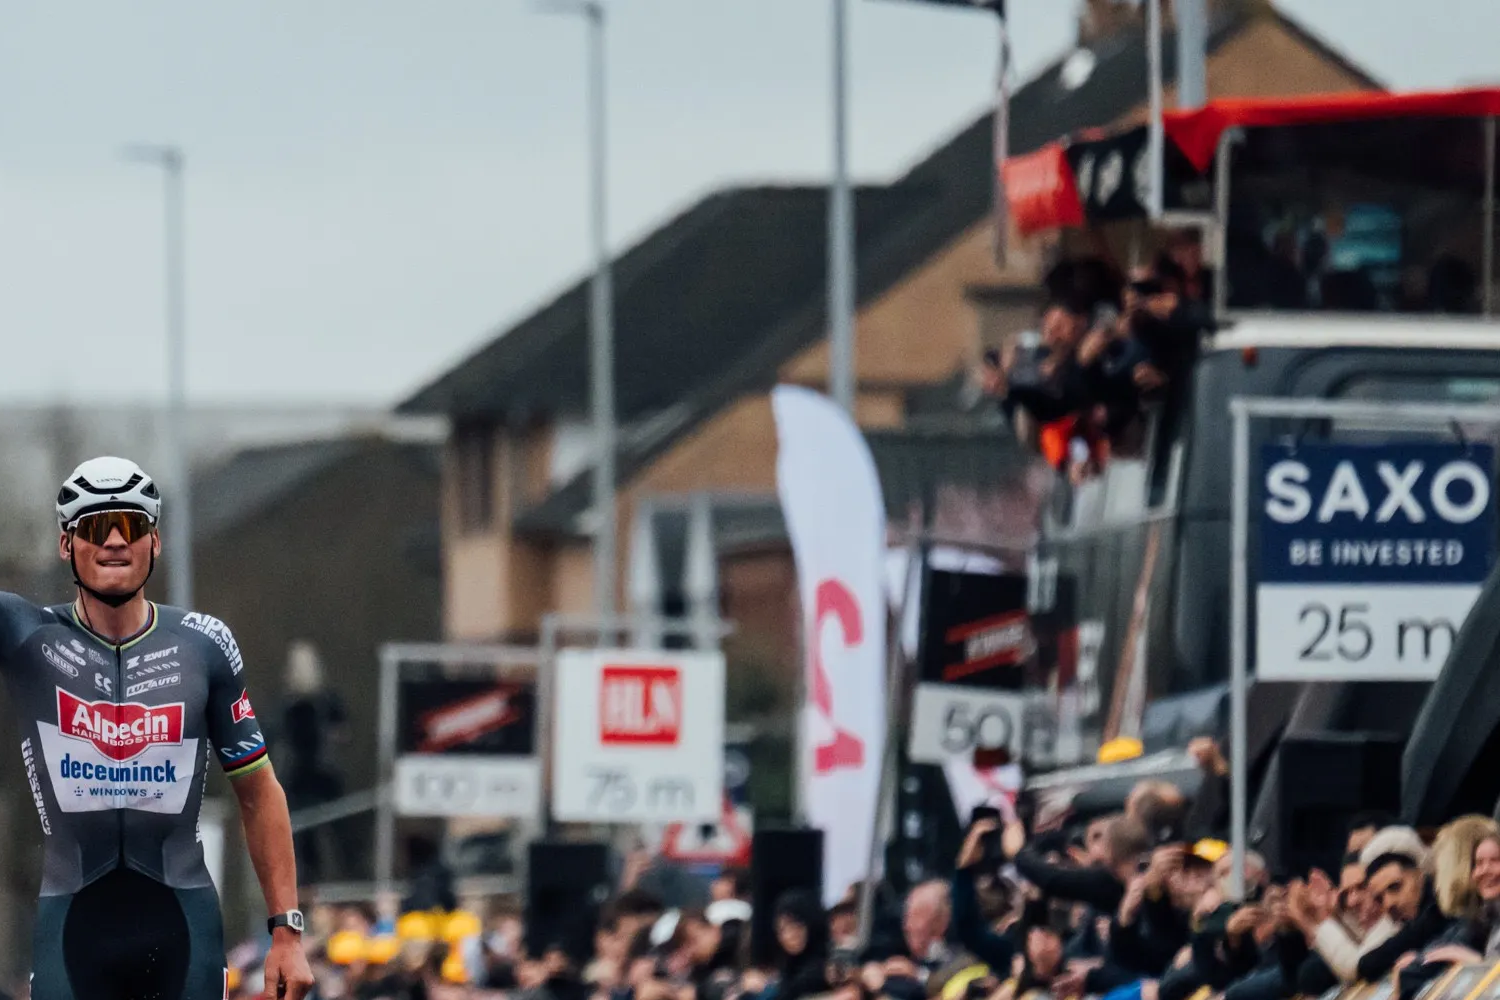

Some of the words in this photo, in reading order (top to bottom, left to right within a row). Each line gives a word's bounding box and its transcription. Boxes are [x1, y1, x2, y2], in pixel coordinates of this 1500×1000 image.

[1266, 460, 1490, 524] SAXO
[1289, 539, 1323, 566] BE
[1331, 539, 1464, 566] INVESTED
[180, 620, 204, 632] HAIR
[209, 631, 238, 676] BOOSTER
[183, 612, 244, 673] Alpecin
[1298, 602, 1374, 661] 25
[1398, 617, 1457, 660] m
[144, 646, 178, 662] ZWIFT
[71, 703, 169, 743] Alpecin
[72, 726, 101, 740] HAIR
[109, 734, 169, 747] BOOSTER
[942, 701, 1012, 754] 50
[60, 752, 177, 782] deceuninck
[89, 787, 148, 797] WINDOWS
